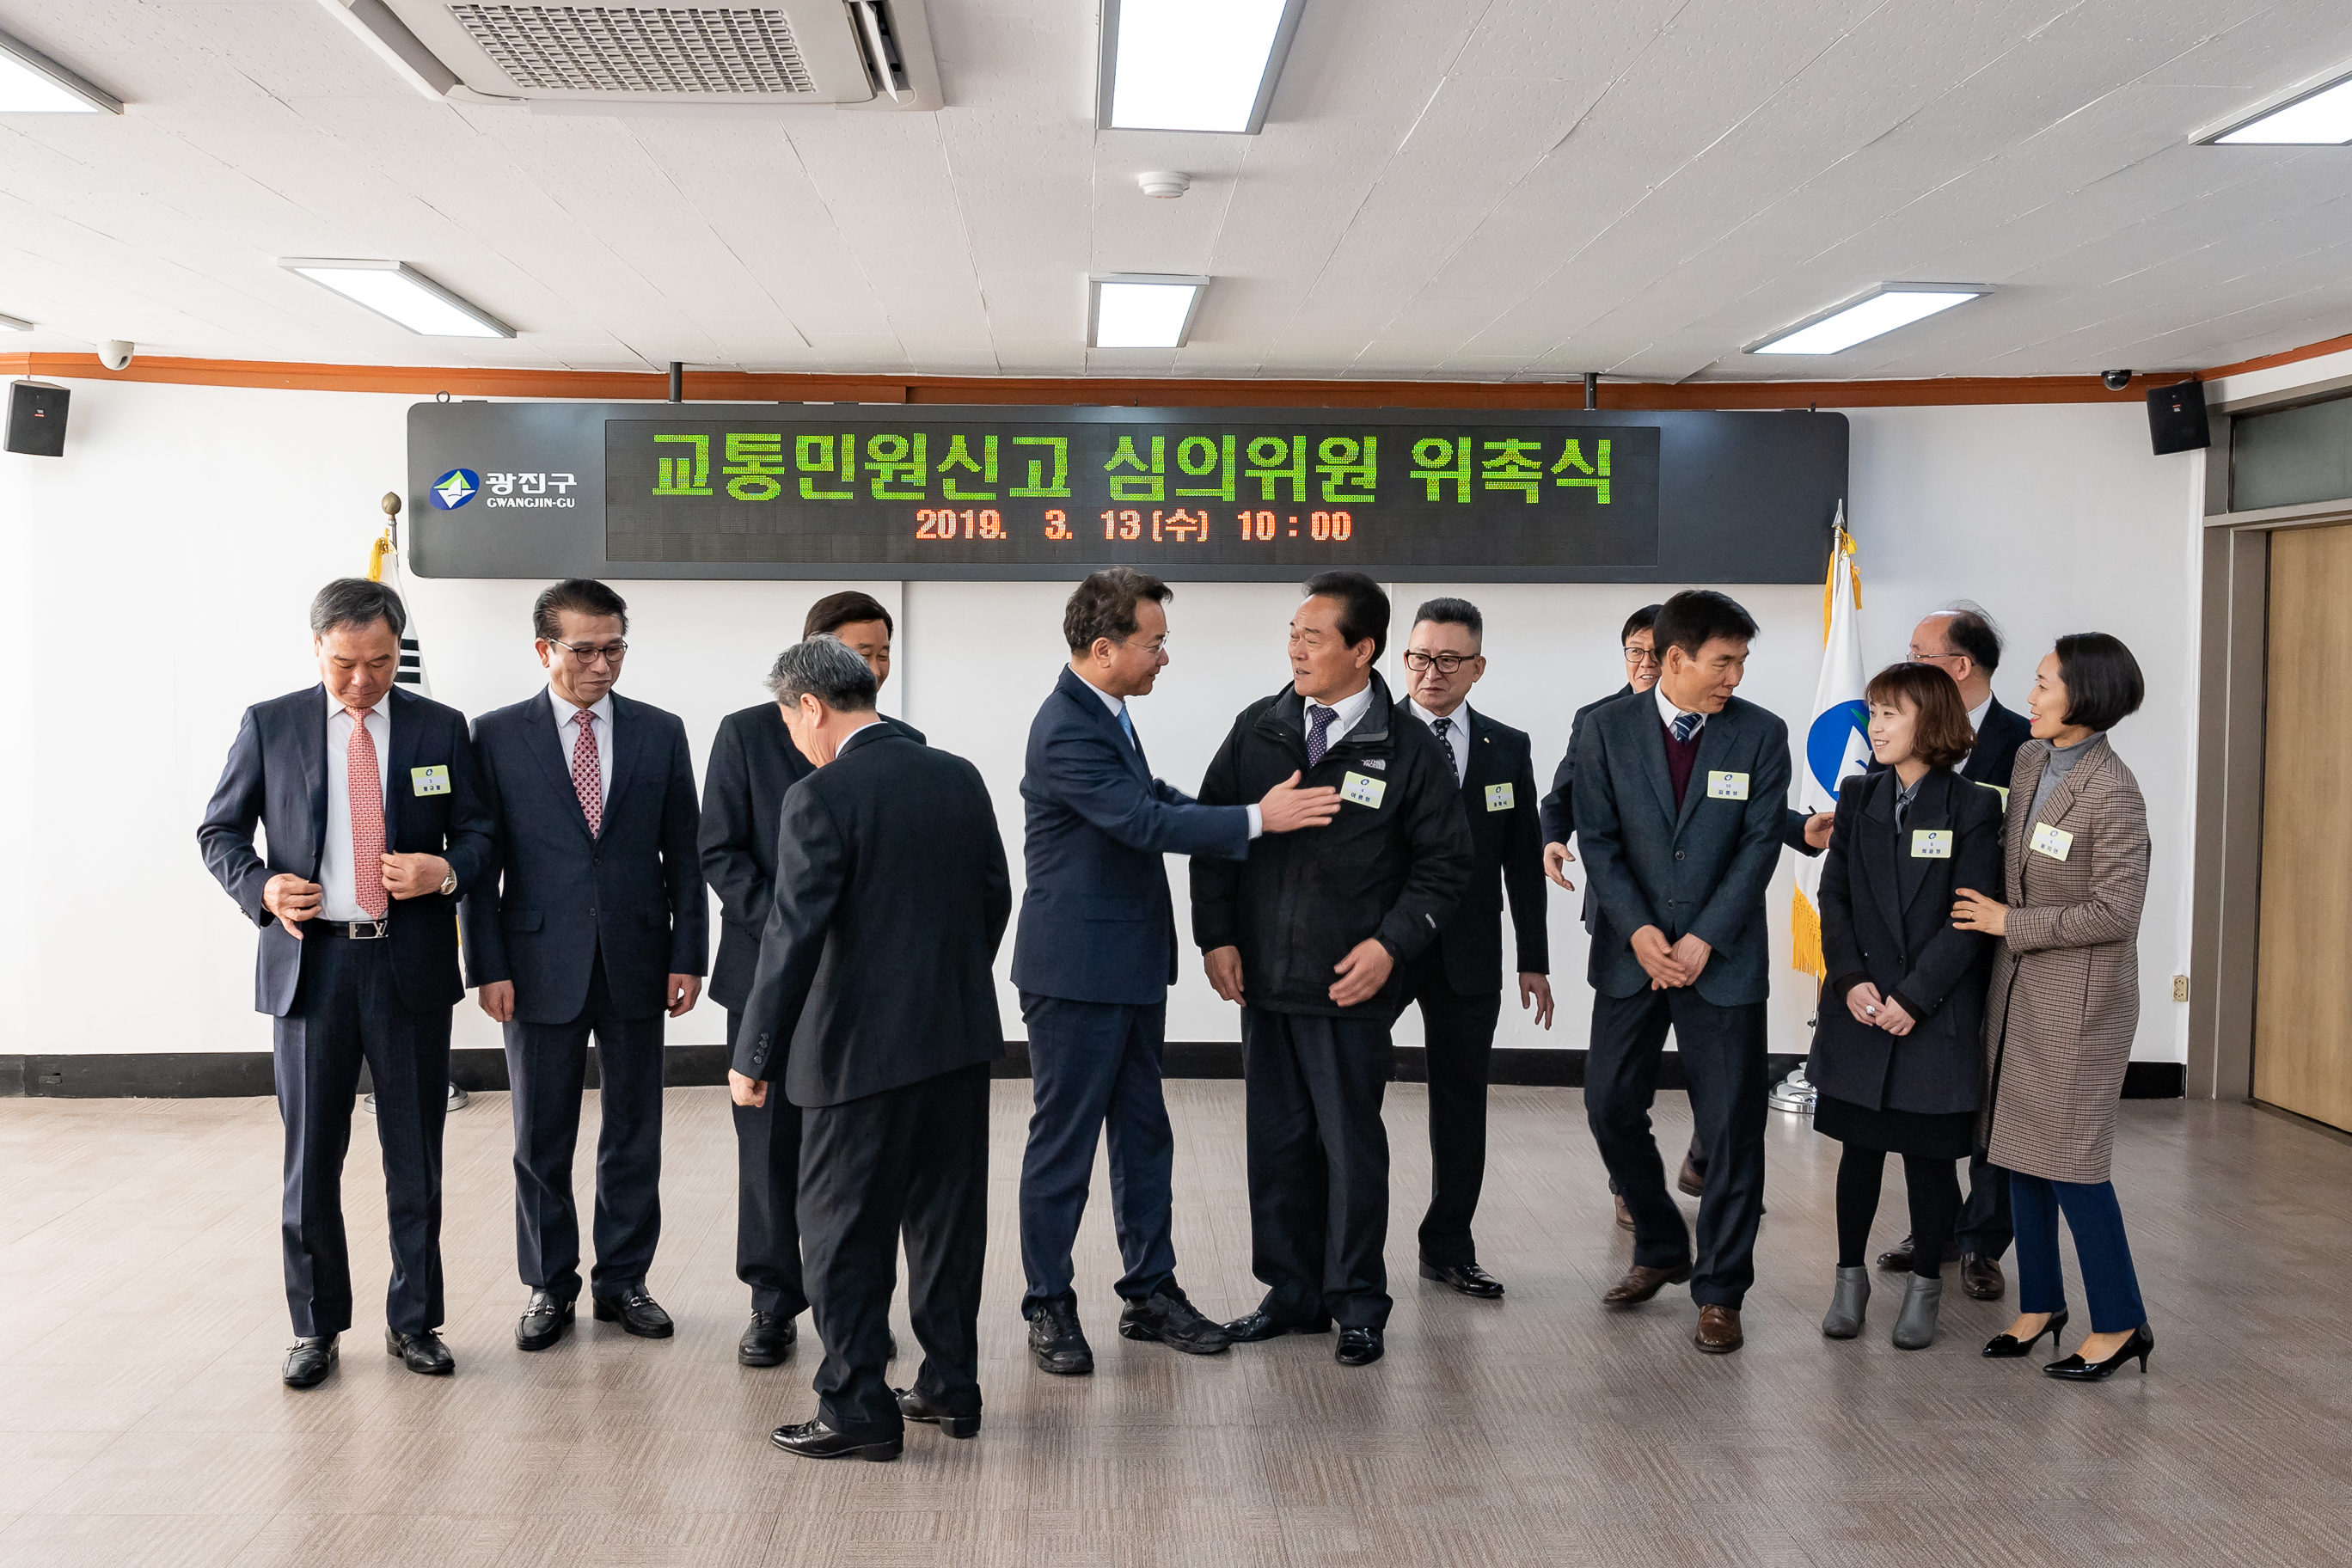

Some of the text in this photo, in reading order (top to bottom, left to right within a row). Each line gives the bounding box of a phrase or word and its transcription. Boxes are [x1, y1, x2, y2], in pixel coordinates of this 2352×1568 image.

[652, 432, 1612, 505] 교통민원신고 심의위원 위촉식
[485, 472, 578, 496] 광진구
[486, 497, 575, 509] GWANGJIN-GU
[916, 508, 1008, 541] 2019.
[1044, 508, 1074, 541] 3.
